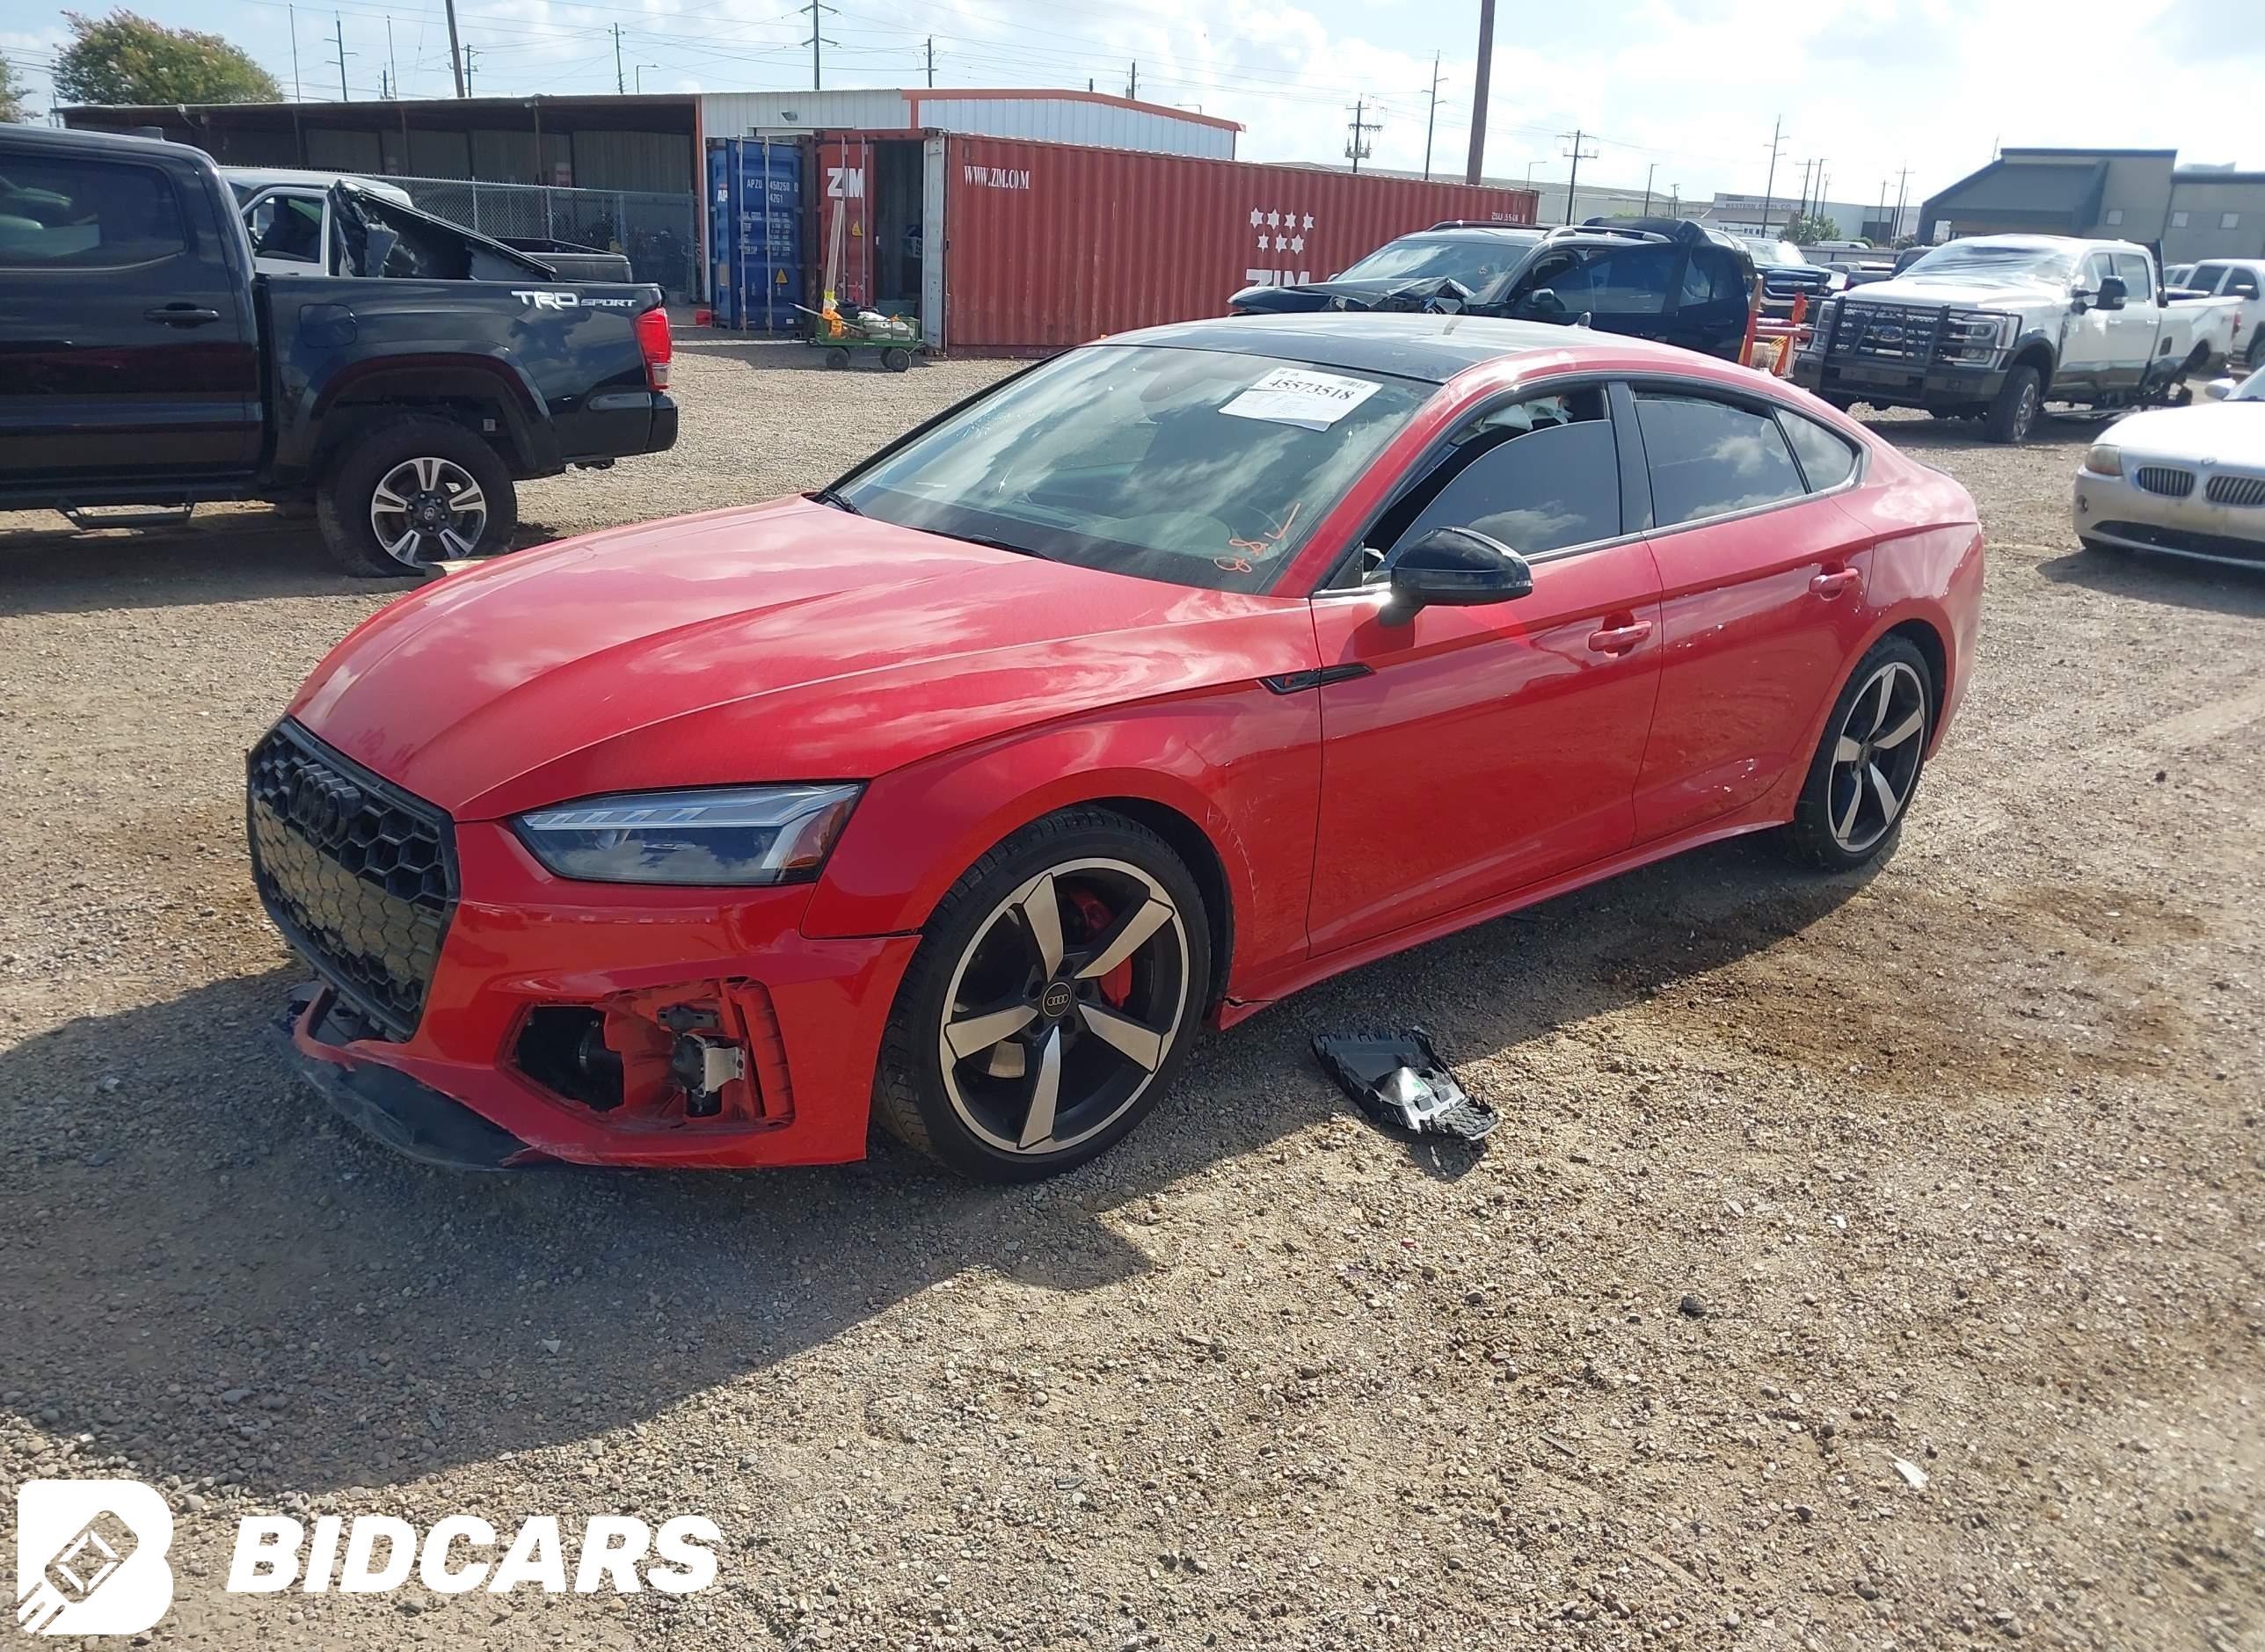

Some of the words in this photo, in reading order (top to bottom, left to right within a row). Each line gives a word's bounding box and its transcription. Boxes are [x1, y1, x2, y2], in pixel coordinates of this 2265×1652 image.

[827, 167, 863, 198] ZIM
[511, 290, 580, 311] TRD
[580, 298, 637, 308] SPORT
[1269, 378, 1356, 401] 45573518
